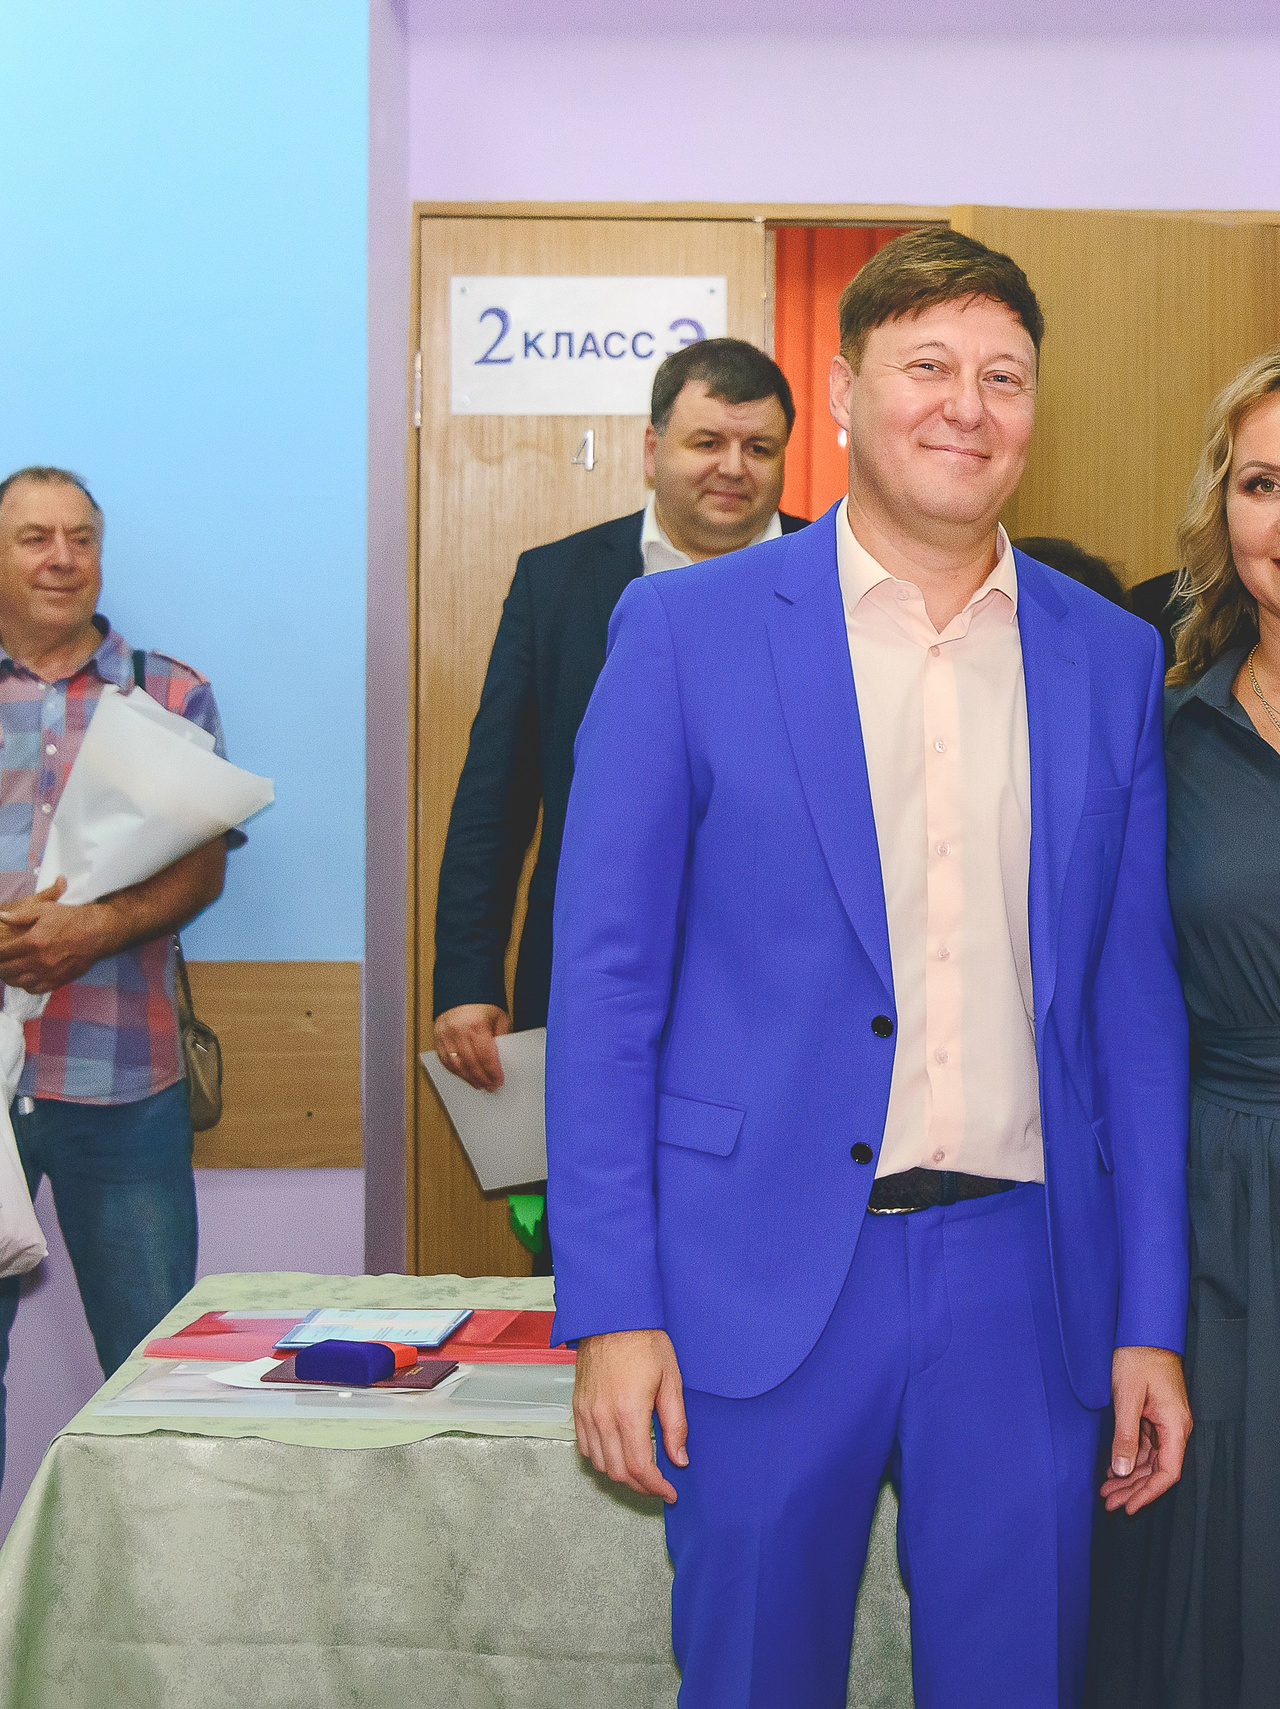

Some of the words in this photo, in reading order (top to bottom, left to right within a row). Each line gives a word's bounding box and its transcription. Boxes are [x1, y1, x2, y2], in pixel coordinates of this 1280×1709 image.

[474, 306, 515, 365] 2
[523, 331, 656, 359] КЛАСС
[571, 429, 597, 471] 4
